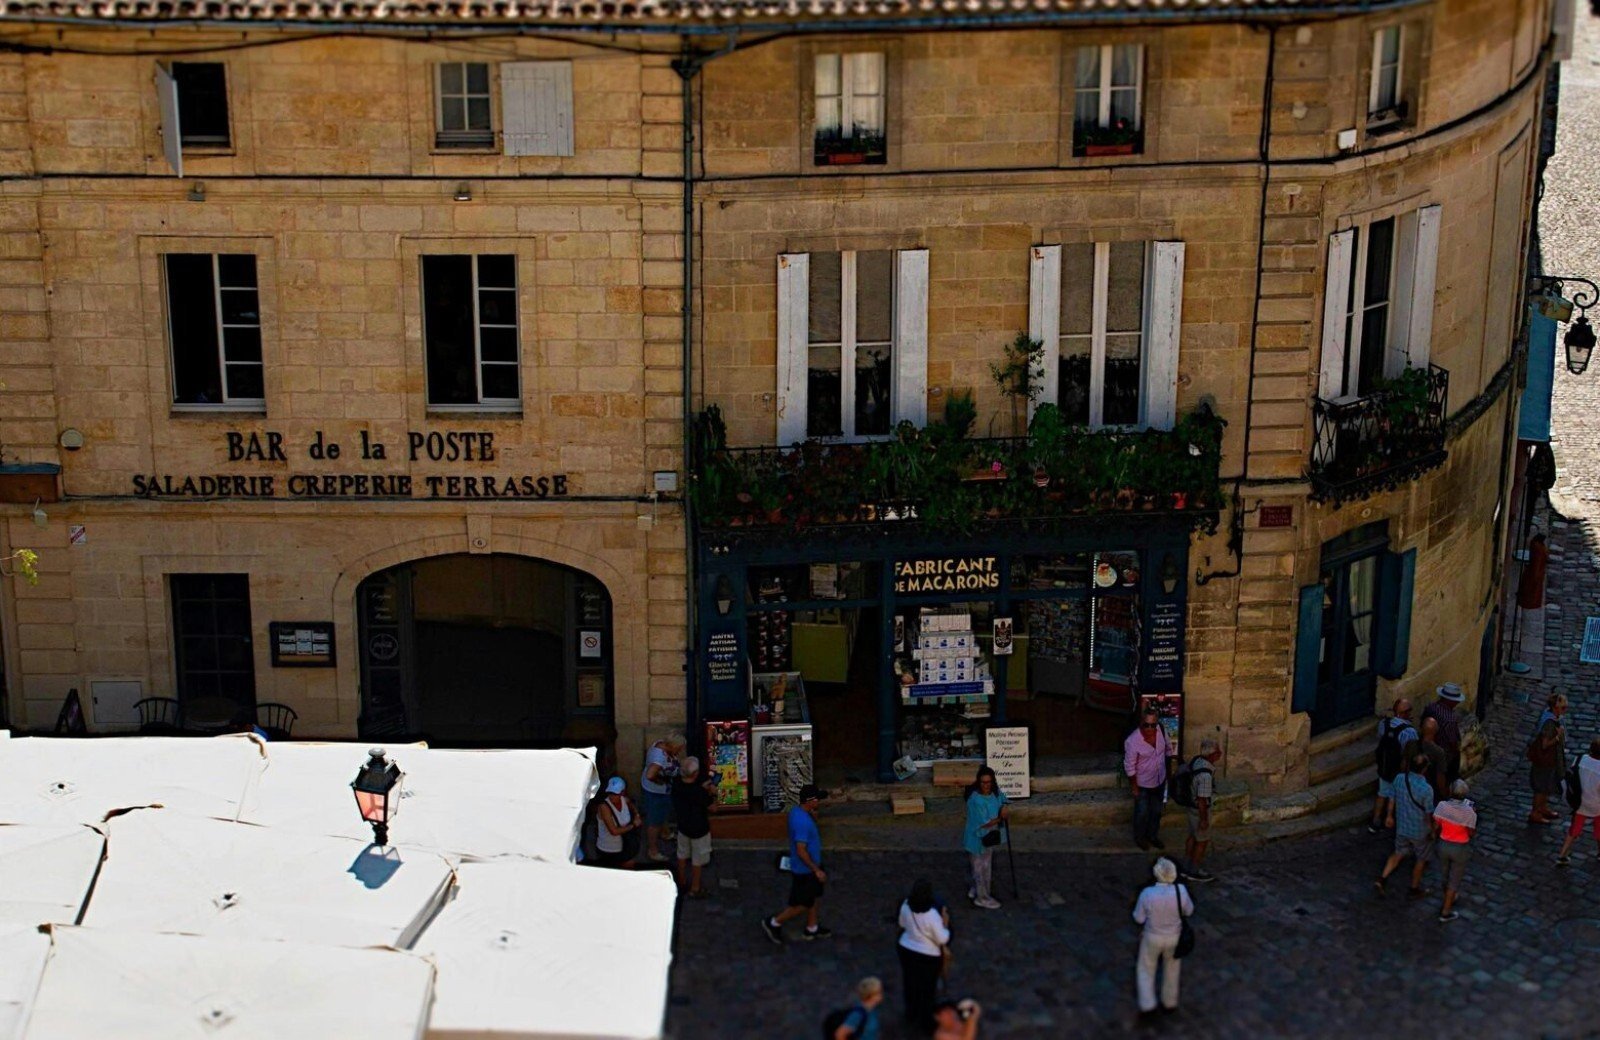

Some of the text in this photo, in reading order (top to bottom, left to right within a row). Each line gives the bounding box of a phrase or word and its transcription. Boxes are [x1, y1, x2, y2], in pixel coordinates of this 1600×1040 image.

[226, 430, 495, 461] BAR de la POSTE
[132, 474, 567, 499] SALADERIE CREPERIE TERRASSE
[894, 557, 996, 576] FABRICANT
[907, 572, 1000, 592] MACARONS
